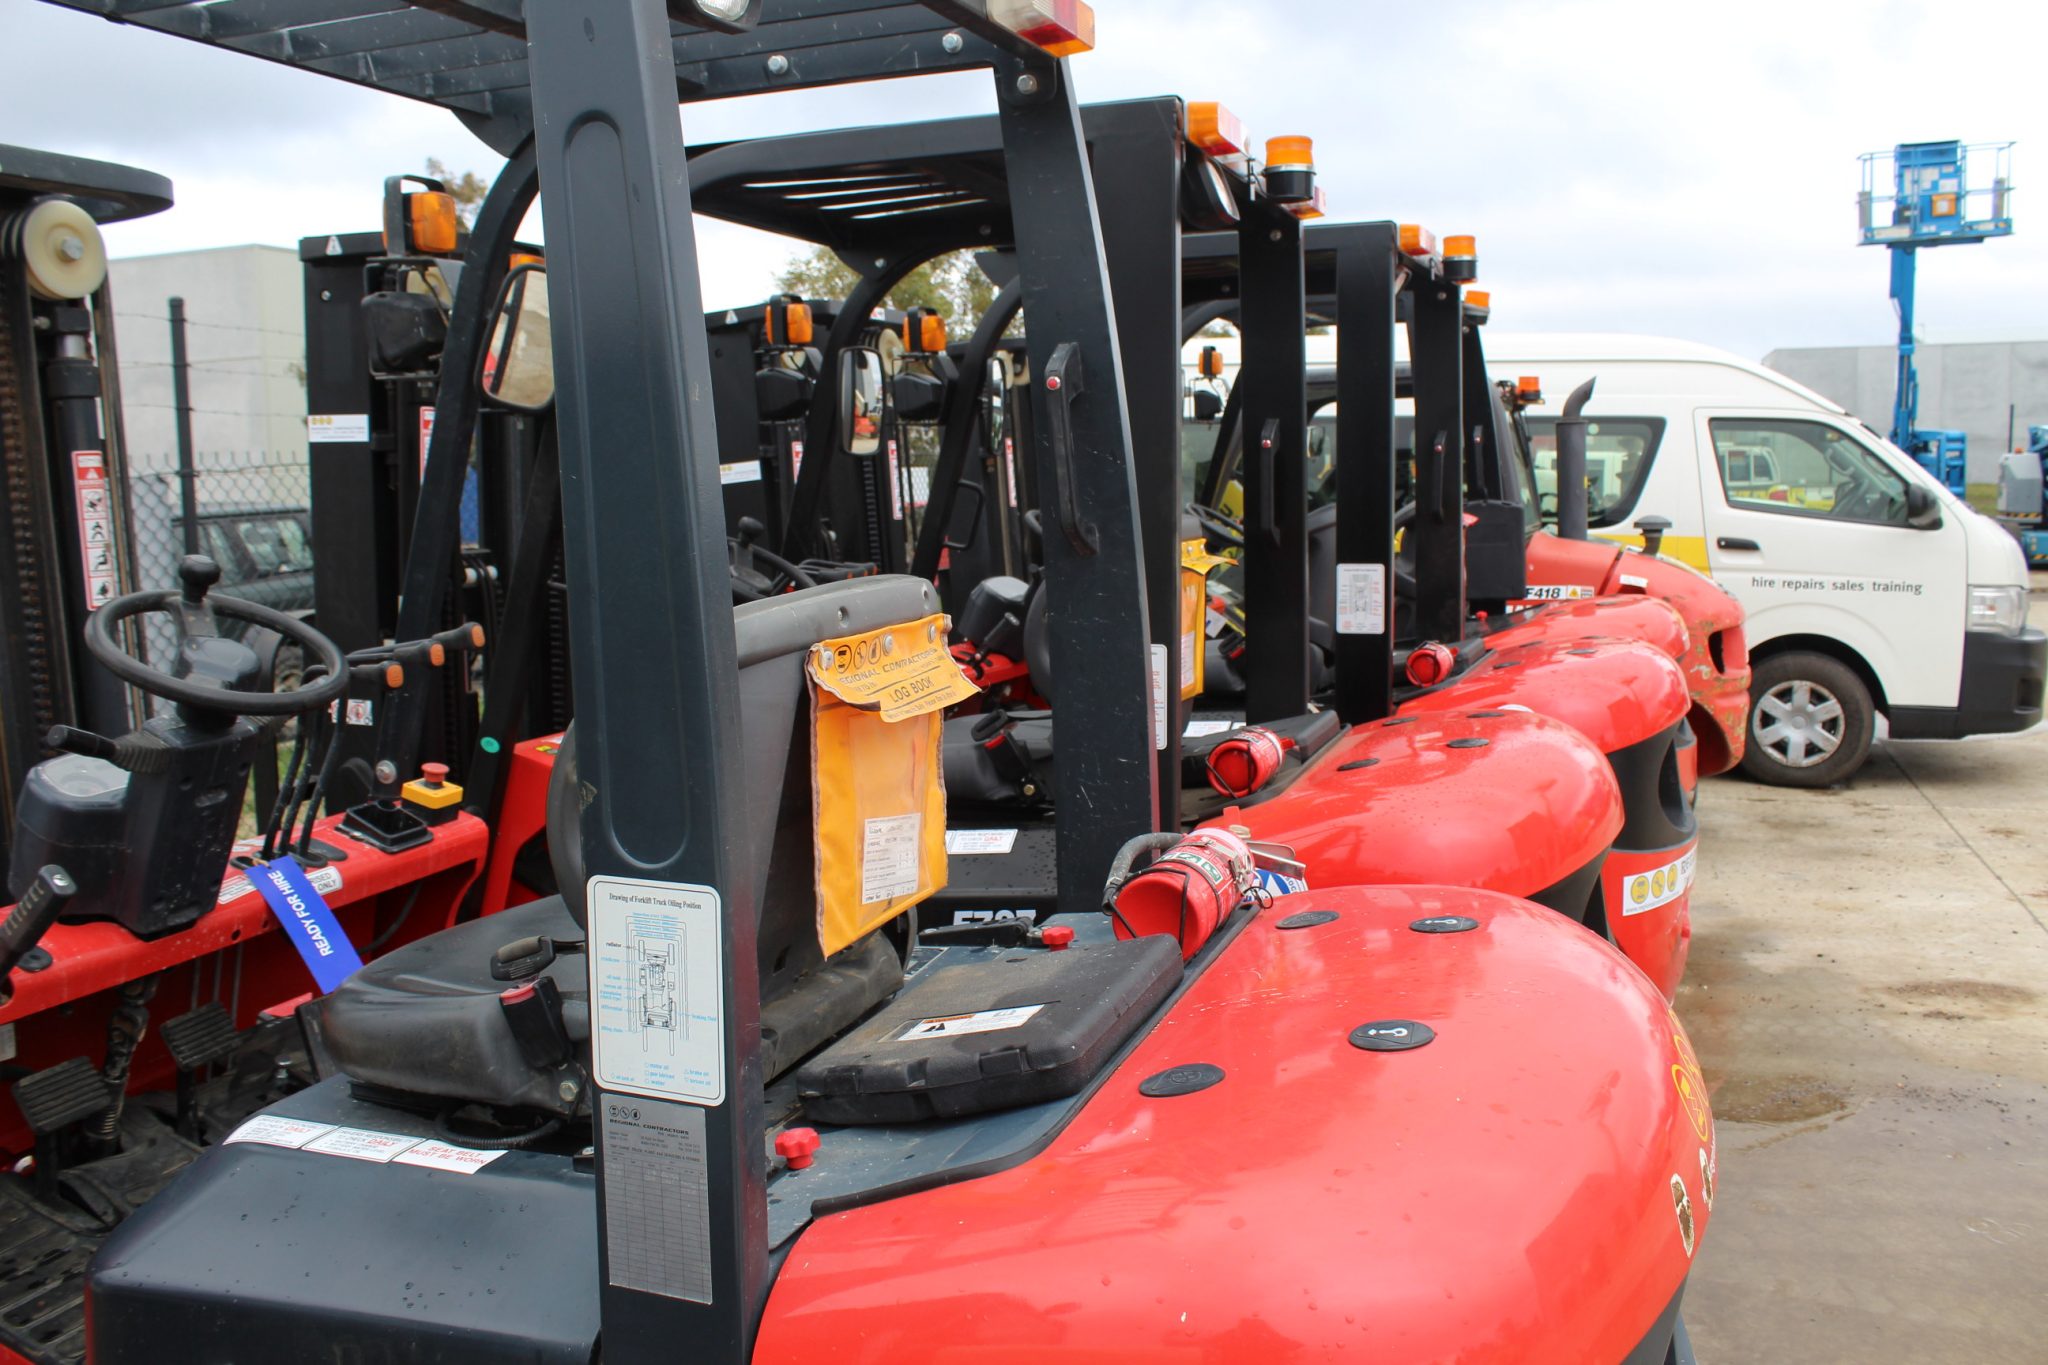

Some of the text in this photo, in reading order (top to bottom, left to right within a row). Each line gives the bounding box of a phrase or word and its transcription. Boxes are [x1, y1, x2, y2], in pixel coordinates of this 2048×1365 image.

[1751, 576, 1923, 596] hire repairs sales training
[889, 685, 911, 703] LOG
[910, 676, 935, 694] BOOK
[609, 892, 629, 904] Drawing
[634, 895, 653, 904] Forklift
[653, 897, 667, 906] Truck
[682, 901, 702, 910] Position
[267, 870, 334, 957] READY FOR HIRE
[609, 1118, 689, 1135] REGIONAL CONTRACTORS
[408, 1148, 436, 1157] MUST
[455, 1156, 487, 1165] WORN
[428, 1146, 456, 1154] SEAT
